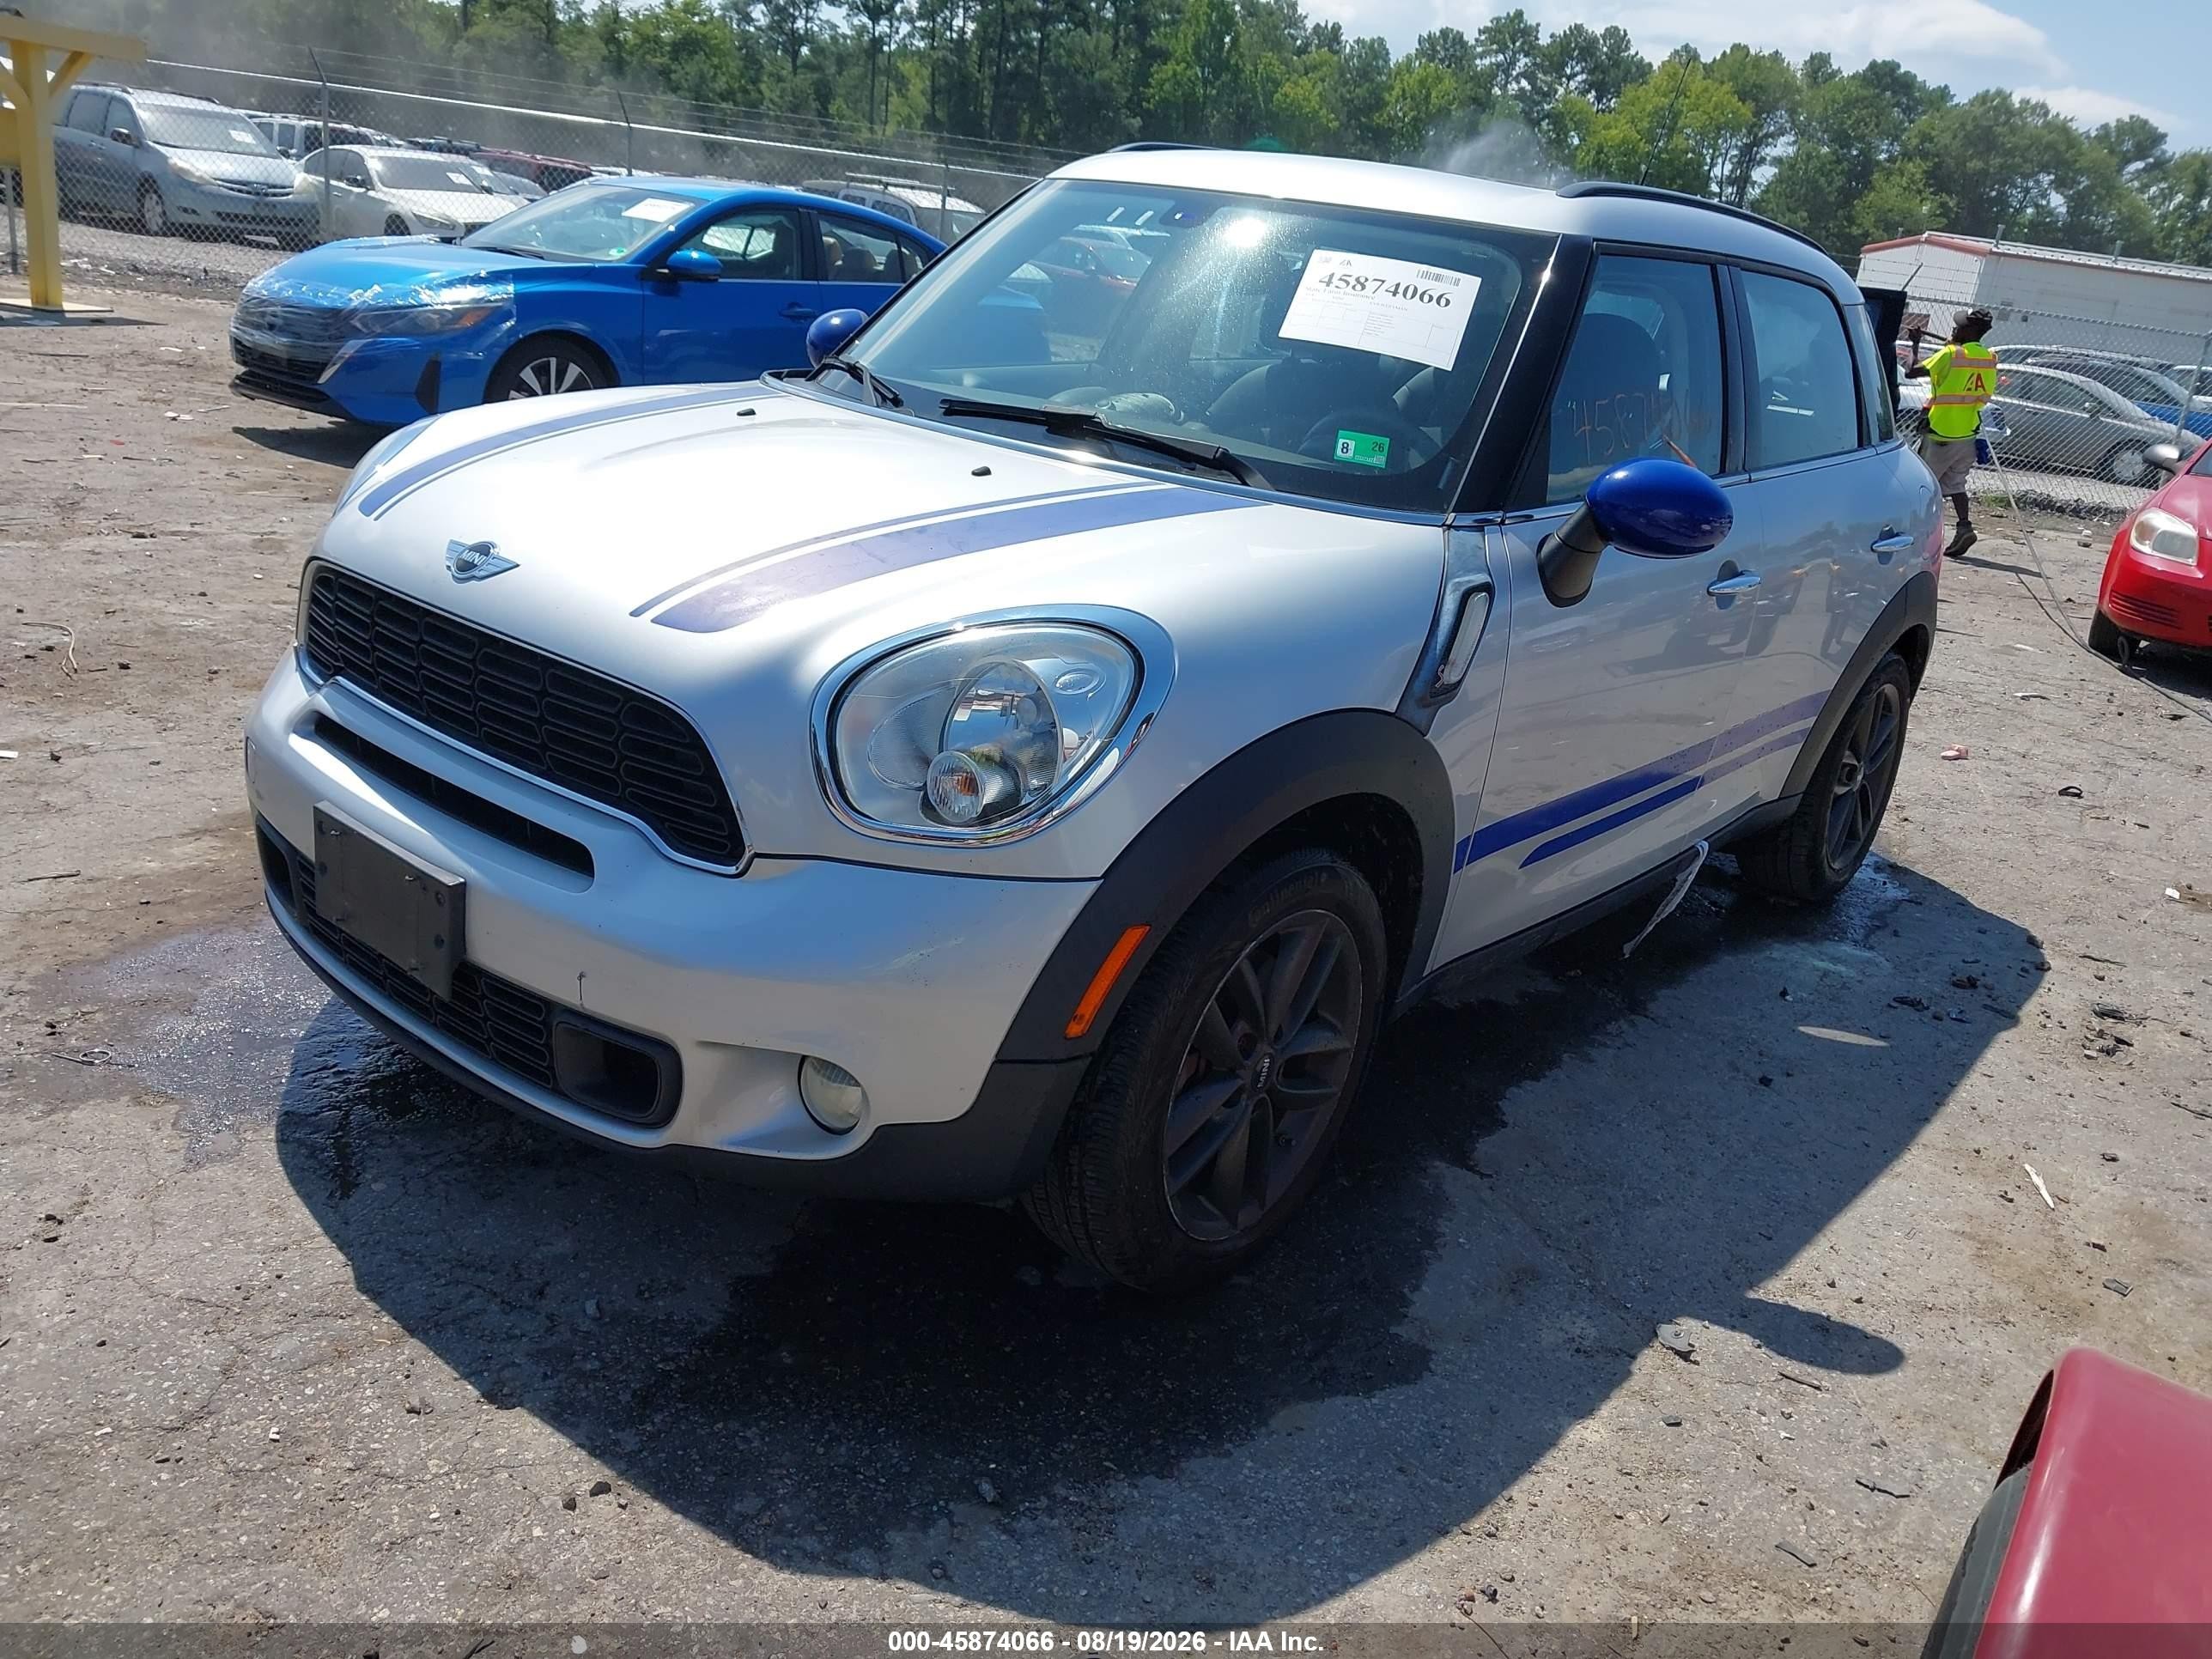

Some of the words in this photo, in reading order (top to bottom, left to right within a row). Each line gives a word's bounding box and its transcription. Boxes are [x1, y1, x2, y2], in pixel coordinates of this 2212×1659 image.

[1318, 271, 1454, 308] 45874066
[1340, 441, 1350, 454] 8
[1371, 441, 1385, 453] 26
[459, 549, 488, 566] MINI
[1256, 1058, 1270, 1088] MINI
